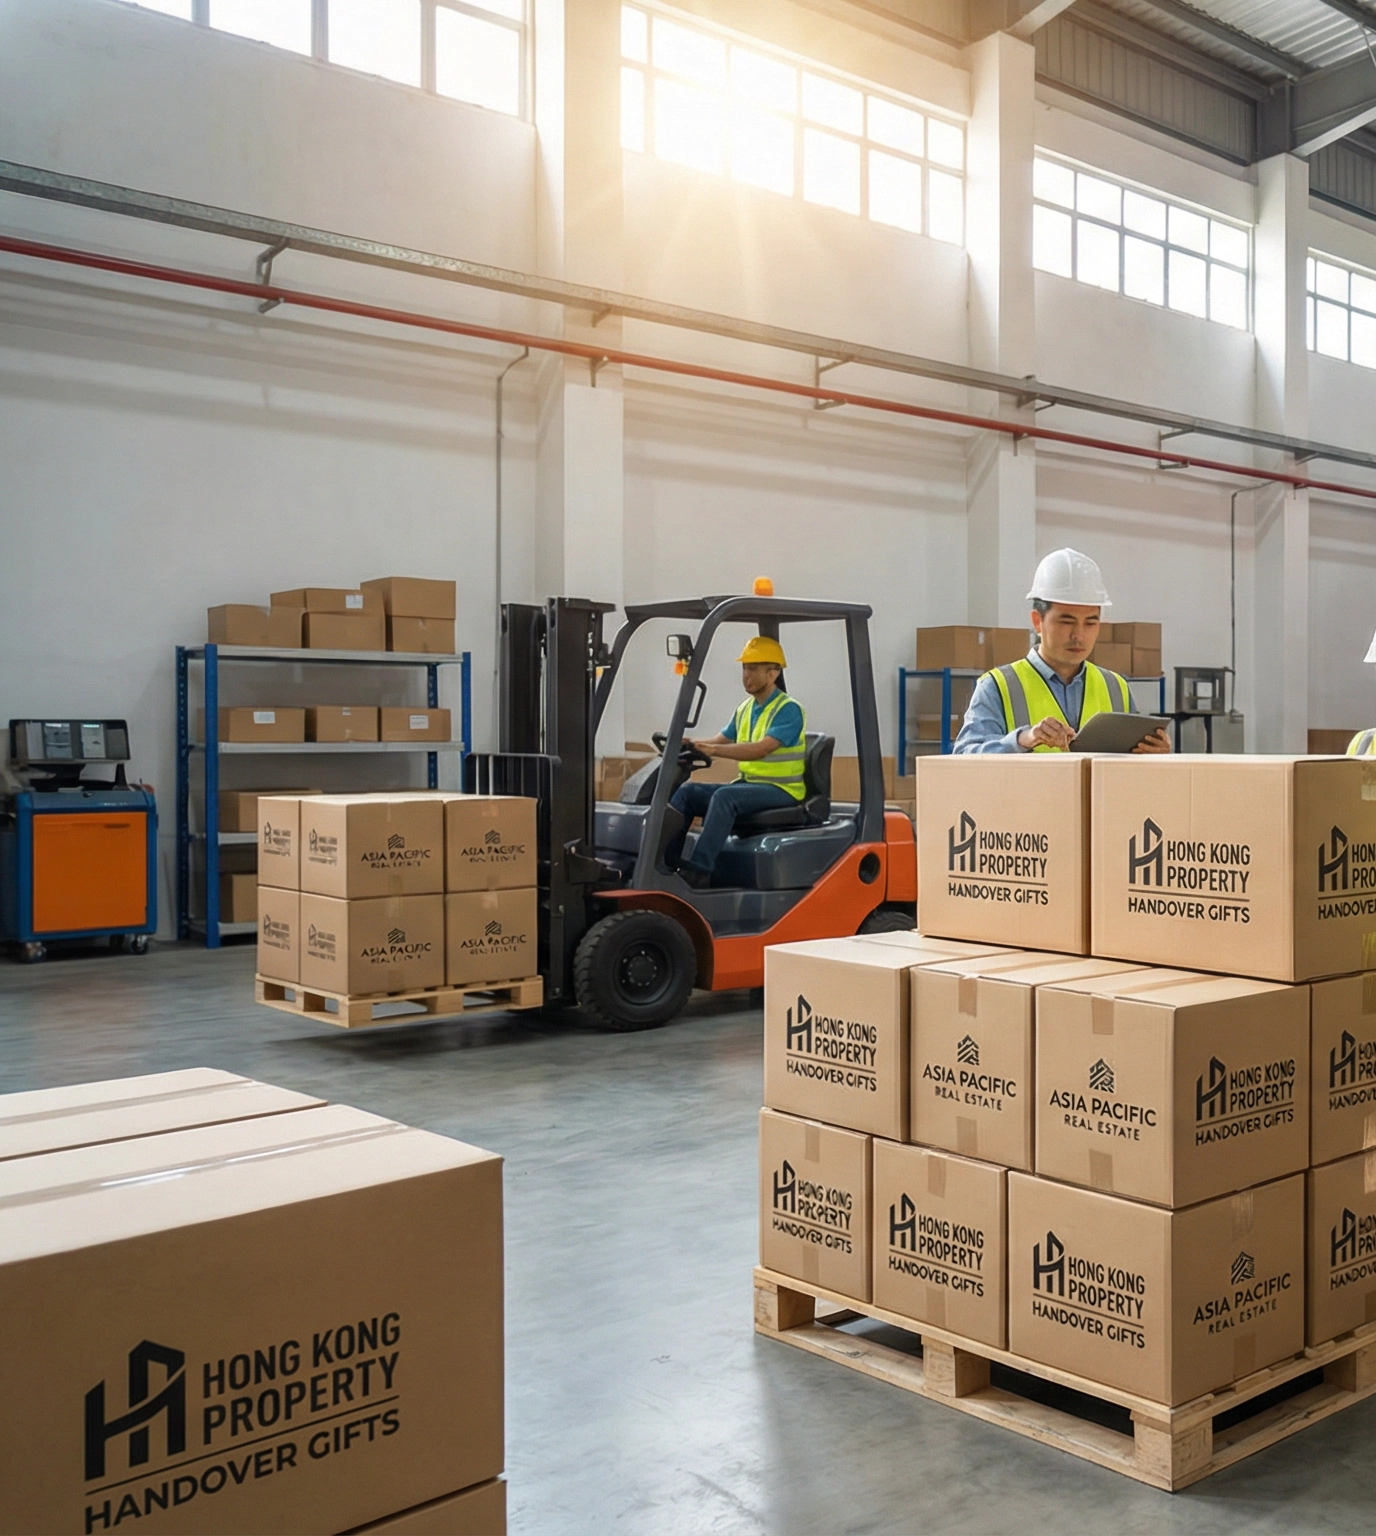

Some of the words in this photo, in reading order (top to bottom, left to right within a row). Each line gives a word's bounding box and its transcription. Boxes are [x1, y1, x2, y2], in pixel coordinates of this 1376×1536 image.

[980, 831, 1012, 850] HONG
[1015, 833, 1048, 853] KONG
[1167, 840, 1205, 862] HONG
[1210, 843, 1250, 865] KONG
[980, 854, 1047, 878] PROPERTY
[1167, 866, 1249, 893] PROPERTY
[949, 882, 1011, 902] HANDOVER
[1014, 888, 1048, 905] GIFTS
[1129, 897, 1204, 919] HANDOVER
[1208, 905, 1250, 923] GIFTS
[815, 1015, 844, 1038] HONG
[847, 1022, 876, 1044] KONG
[815, 1036, 876, 1066] PROPERTY
[787, 1059, 844, 1085] HANDOVER
[923, 1063, 956, 1085] ASIA
[960, 1071, 1016, 1097] PACIFIC
[1231, 1067, 1261, 1090] HONG
[1265, 1059, 1295, 1082] KONG
[965, 1093, 1002, 1111] ESTATE
[1050, 1089, 1087, 1112] ASIA
[1092, 1098, 1156, 1126] PACIFIC
[1230, 1079, 1294, 1112] PROPERTY
[1064, 1114, 1093, 1131] REAL
[1098, 1121, 1140, 1141] ESTATE
[1196, 1117, 1261, 1146] HANDOVER
[919, 1214, 949, 1239] HONG
[952, 1223, 984, 1249] KONG
[920, 1235, 983, 1270] PROPERTY
[889, 1256, 949, 1287] HANDOVER
[1069, 1256, 1104, 1284] HONG
[1108, 1267, 1145, 1295] KONG
[1069, 1279, 1143, 1319] PROPERTY
[1193, 1297, 1230, 1325] ASIA
[1235, 1273, 1290, 1308] PACIFIC
[1033, 1301, 1103, 1336] HANDOVER
[1107, 1324, 1145, 1349] GIFTS
[1208, 1317, 1234, 1335] REAL
[1240, 1299, 1276, 1323] ESTATE
[203, 1340, 300, 1399] HONG
[312, 1312, 400, 1368] KONG
[203, 1351, 399, 1445] PROPERTY
[85, 1442, 297, 1535] HANDOVER
[308, 1408, 400, 1459] GIFTS
